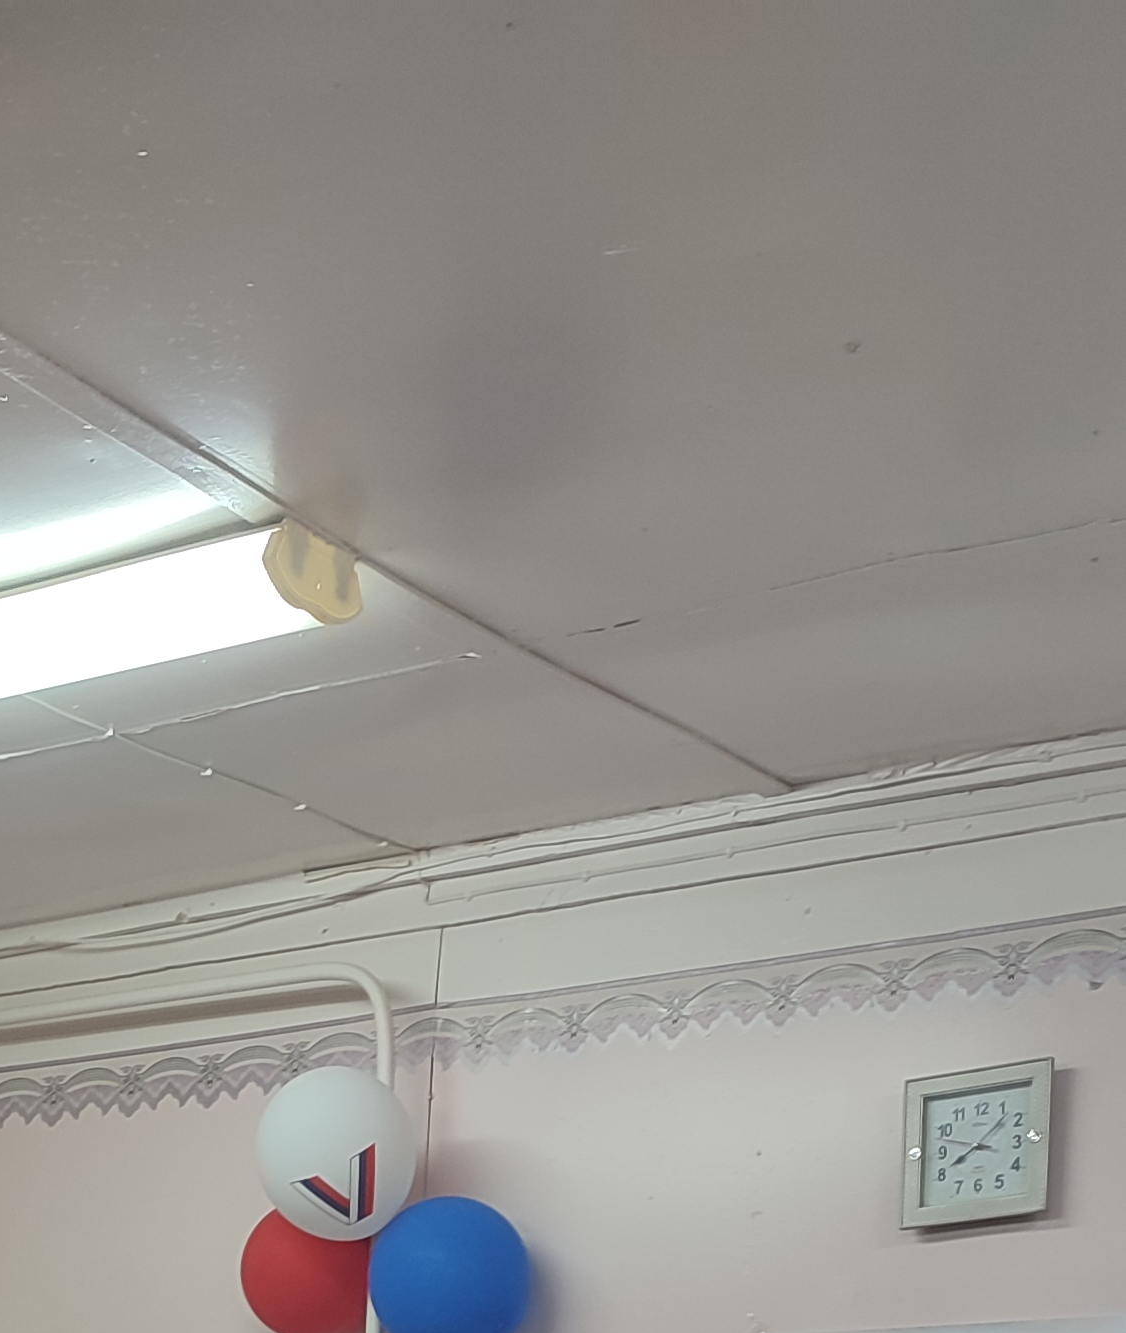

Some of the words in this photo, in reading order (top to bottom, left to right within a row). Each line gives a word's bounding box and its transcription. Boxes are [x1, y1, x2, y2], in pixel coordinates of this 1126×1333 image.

[952, 1107, 966, 1122] 11
[974, 1101, 990, 1115] 12
[998, 1101, 1006, 1115] 1
[1013, 1112, 1023, 1127] 2
[937, 1123, 953, 1138] 10
[1012, 1134, 1022, 1150] 3
[938, 1145, 948, 1160] 9
[1010, 1157, 1021, 1172] 4
[937, 1168, 947, 1182] 8
[994, 1174, 1005, 1189] 5
[953, 1180, 964, 1195] 7
[974, 1178, 983, 1192] 6
